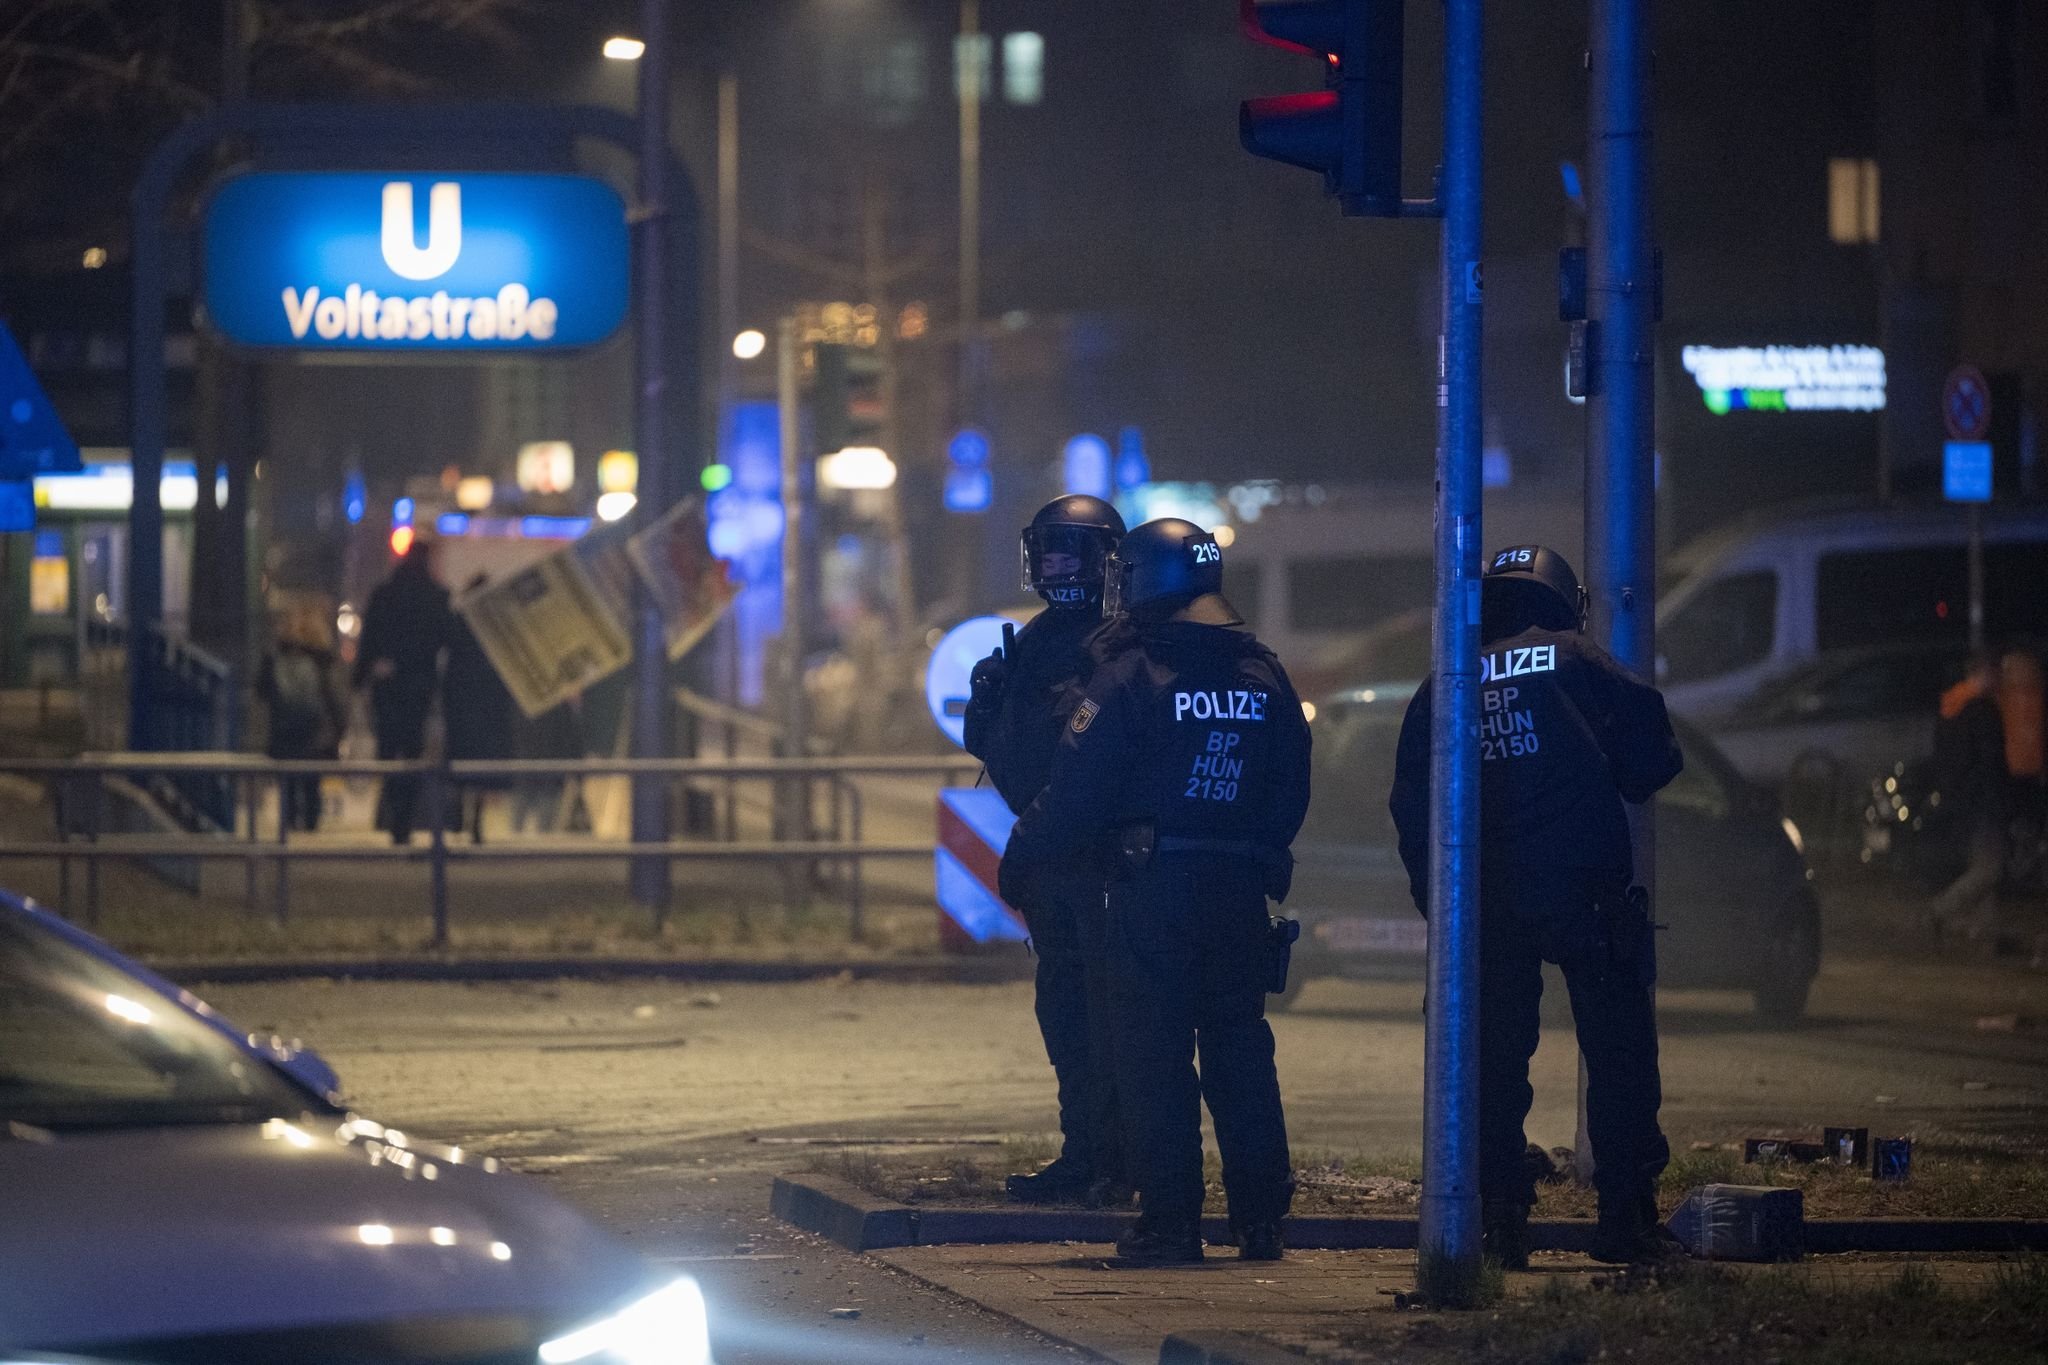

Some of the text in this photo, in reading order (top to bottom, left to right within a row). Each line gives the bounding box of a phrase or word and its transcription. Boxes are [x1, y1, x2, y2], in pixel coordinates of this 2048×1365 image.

[381, 182, 461, 280] U
[282, 283, 558, 340] Voltastraße
[1192, 542, 1220, 563] 215
[1495, 549, 1531, 567] 215
[1047, 588, 1085, 601] LIZEI
[1483, 686, 1519, 712] BP
[1480, 708, 1534, 738] HÜN
[1206, 731, 1240, 753] BP
[1482, 732, 1539, 760] 2150
[1192, 753, 1243, 780] HÜN
[1184, 777, 1238, 801] 2150
